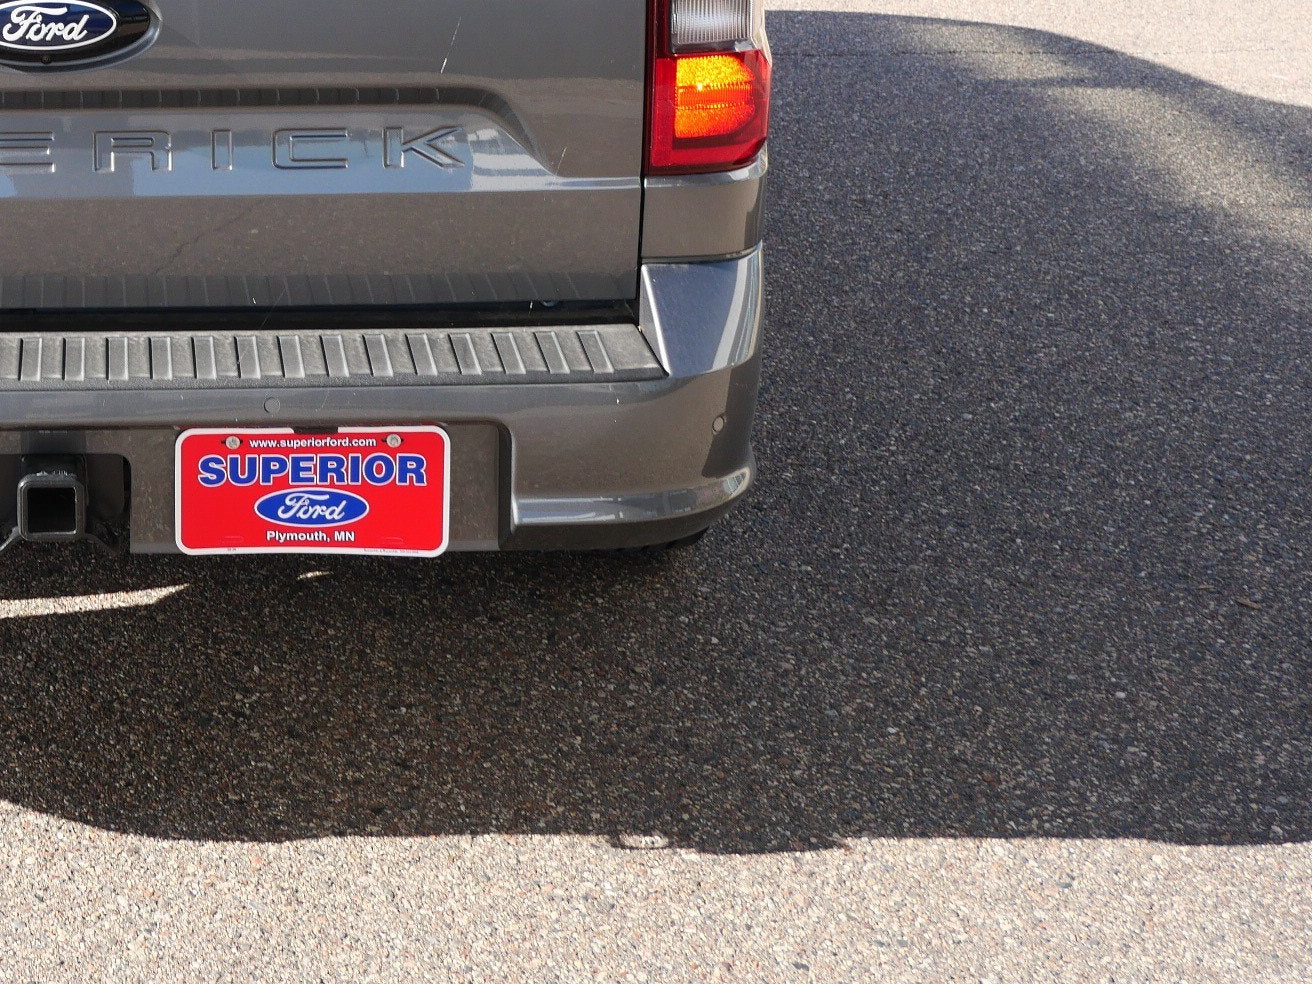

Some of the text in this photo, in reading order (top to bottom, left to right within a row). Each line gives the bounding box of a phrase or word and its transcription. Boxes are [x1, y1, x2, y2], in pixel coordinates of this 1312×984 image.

[2, 5, 90, 42] Ford
[249, 436, 377, 449] www.superiorford.com
[197, 452, 428, 487] SUPERIOR
[277, 492, 348, 521] Ford
[265, 530, 355, 543] Plymouth, MN
